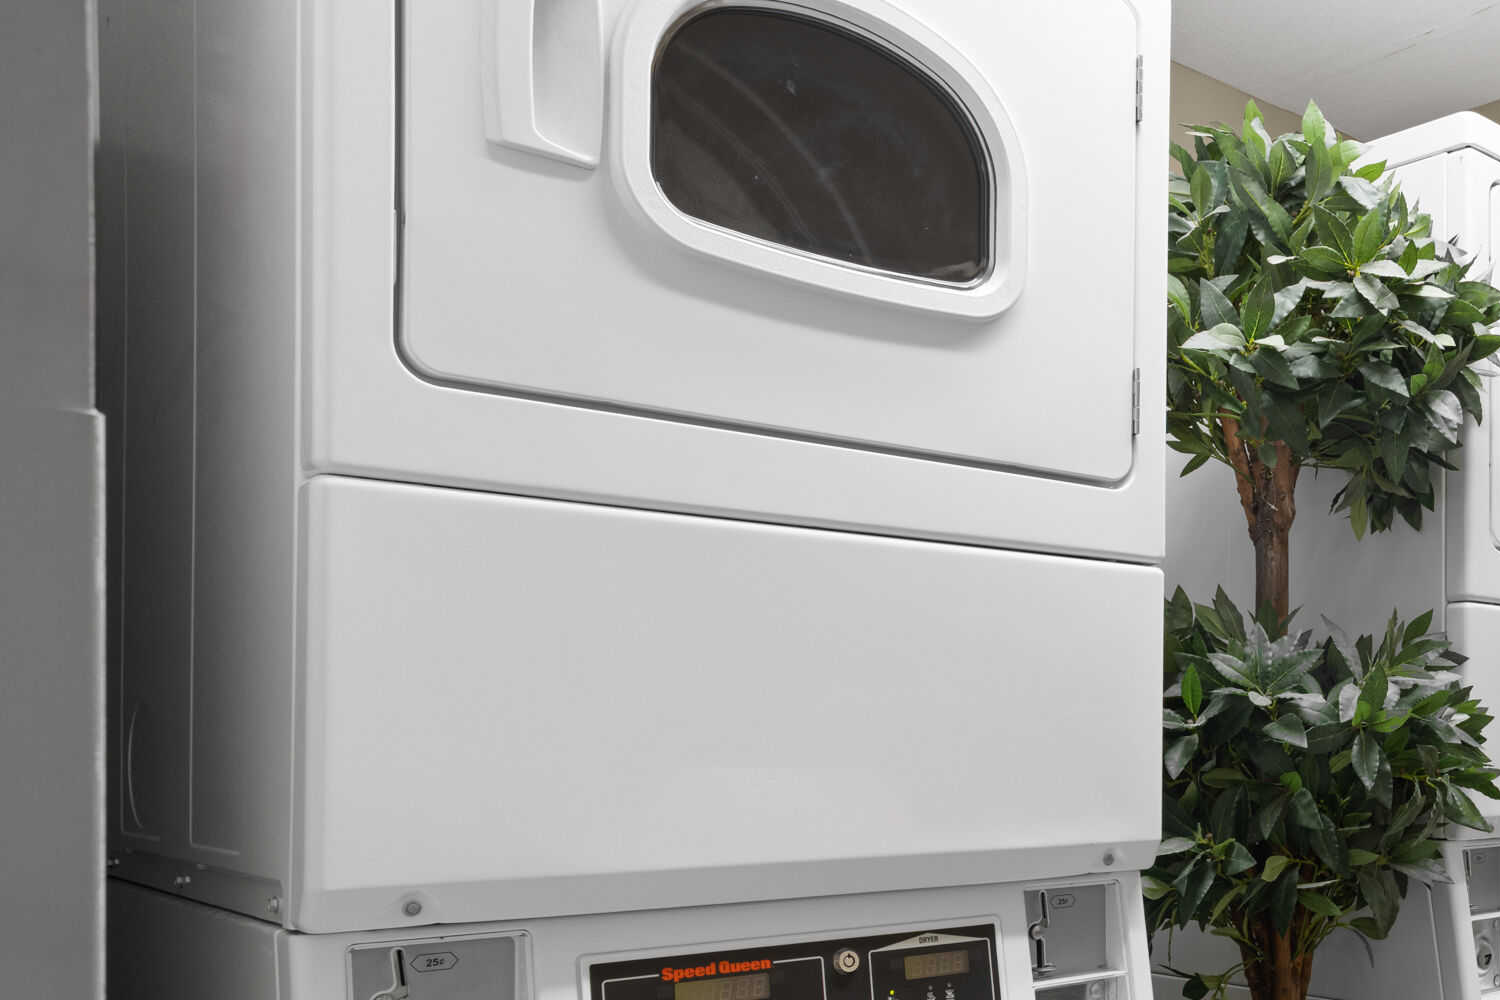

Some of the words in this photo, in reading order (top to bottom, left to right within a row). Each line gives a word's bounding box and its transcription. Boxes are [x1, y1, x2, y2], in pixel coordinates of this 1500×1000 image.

[919, 935, 939, 944] DRYER
[661, 962, 716, 982] Speed
[719, 959, 771, 974] Queen
